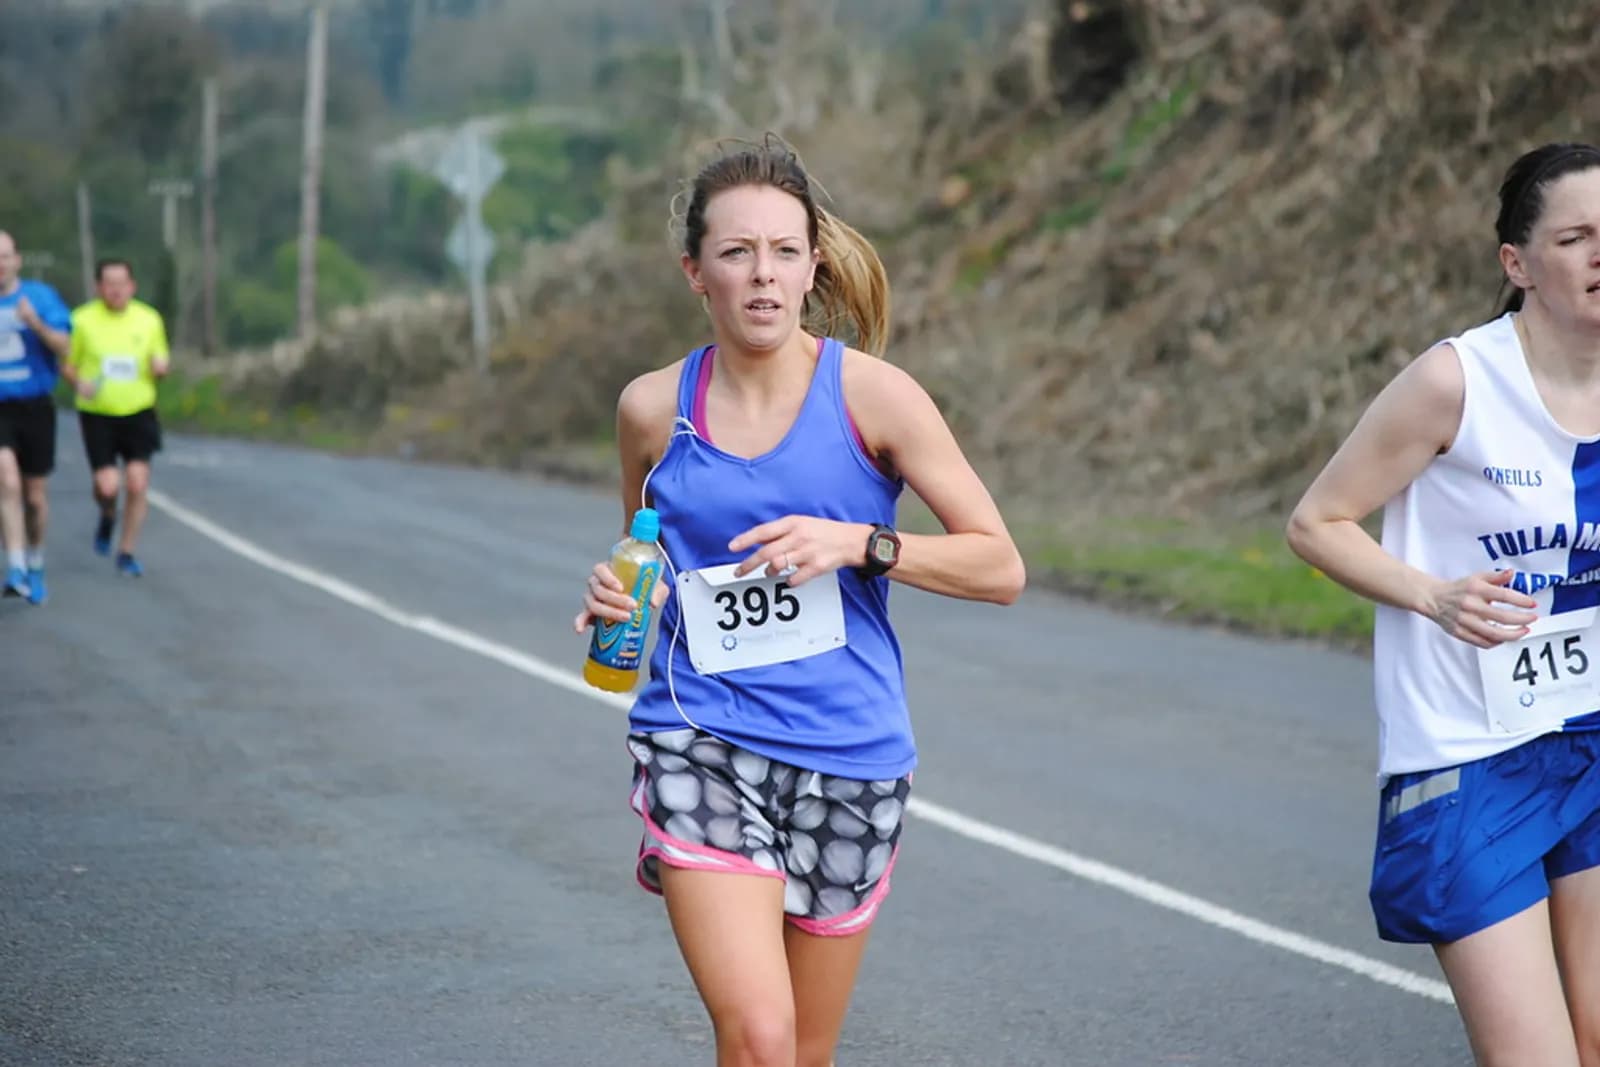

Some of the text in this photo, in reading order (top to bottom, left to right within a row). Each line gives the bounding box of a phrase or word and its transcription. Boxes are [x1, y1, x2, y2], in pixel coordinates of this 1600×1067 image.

[1483, 466, 1543, 487] O'NEILLS
[715, 582, 800, 631] 395
[1512, 635, 1589, 686] 415
